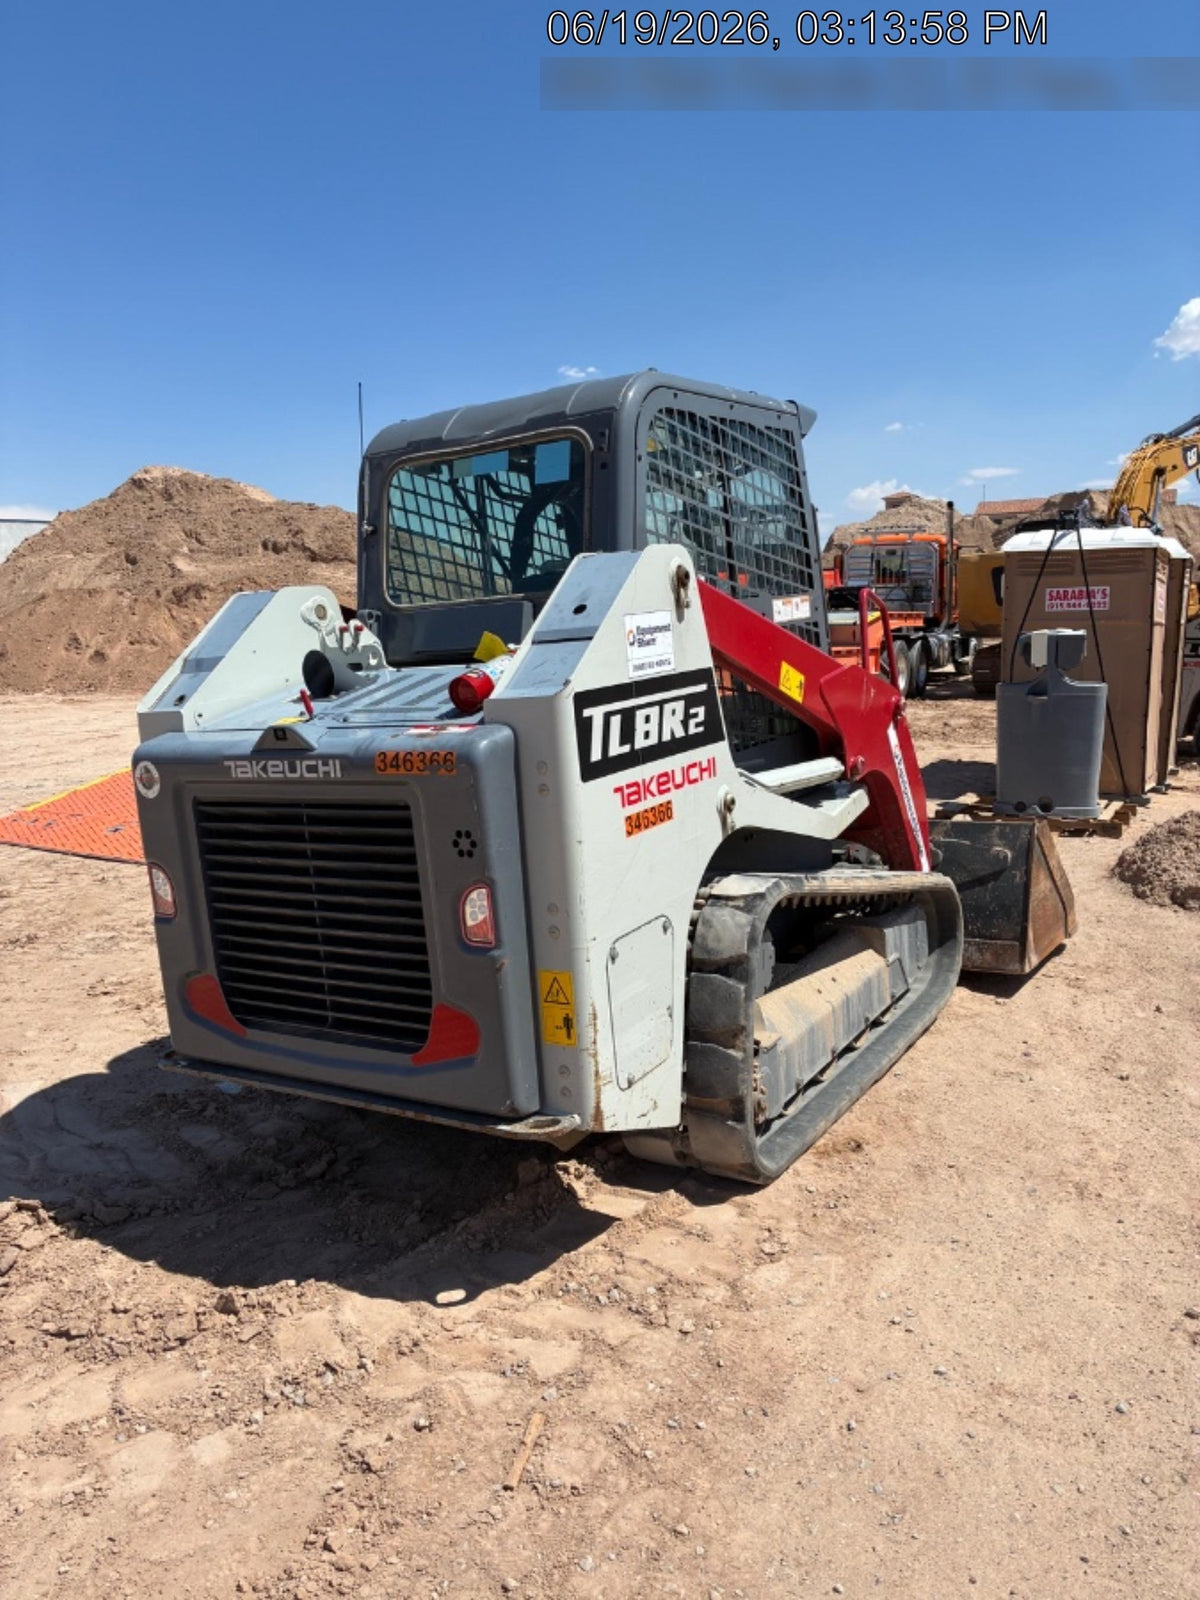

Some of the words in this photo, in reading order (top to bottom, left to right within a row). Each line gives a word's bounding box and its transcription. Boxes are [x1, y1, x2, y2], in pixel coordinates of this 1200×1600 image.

[1048, 588, 1108, 602] SARABA'S
[224, 758, 341, 778] TAKEUCHI
[376, 751, 455, 773] 346366
[613, 757, 717, 809] TAKEUCHI
[625, 800, 674, 837] 346366
